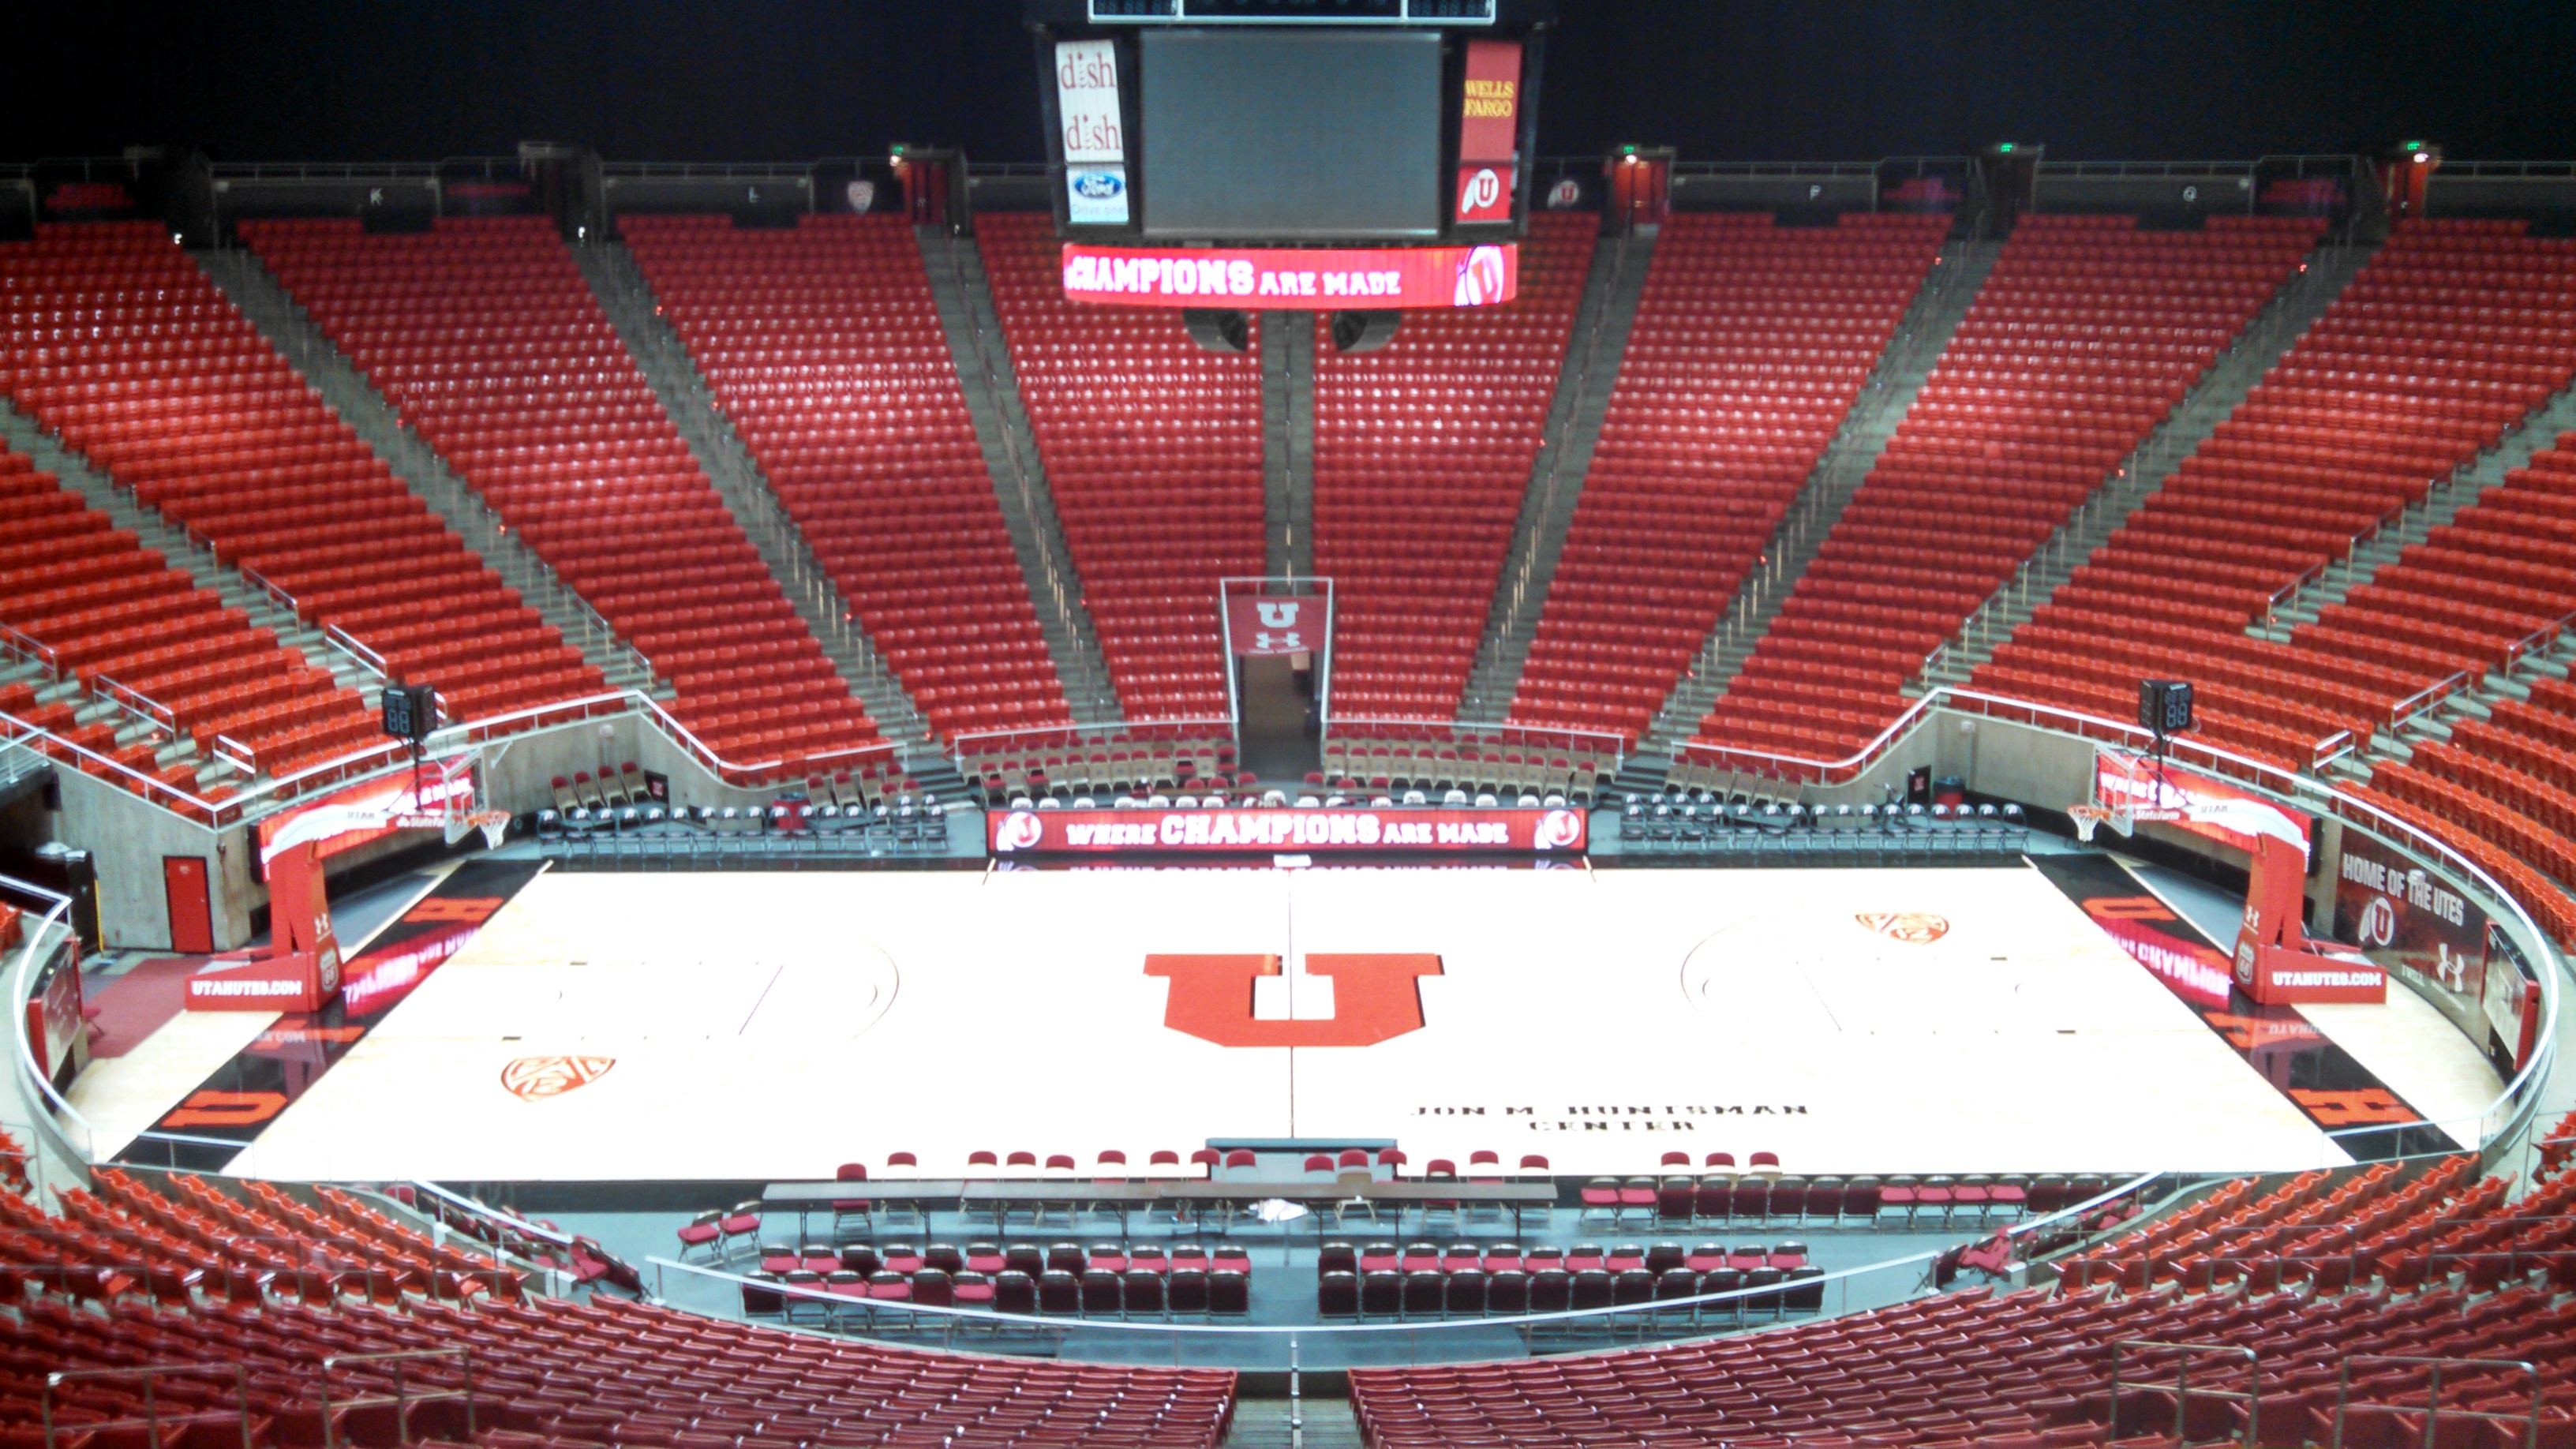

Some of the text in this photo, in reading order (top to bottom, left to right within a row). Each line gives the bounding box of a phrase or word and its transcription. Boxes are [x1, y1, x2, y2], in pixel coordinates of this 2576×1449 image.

[1465, 80, 1514, 99] WELLS
[1463, 99, 1513, 117] FARGO
[1081, 174, 1115, 196] Ford
[1259, 271, 1317, 295] ARE
[1322, 271, 1402, 295] MADE
[1256, 602, 1299, 628] U
[1066, 814, 1509, 845] WHERE CHAMPIONS ARE MADE
[2342, 852, 2464, 927] HOME OF THE UTES
[2374, 904, 2391, 942] U
[191, 980, 302, 996] UTAHUTES.COM
[2272, 972, 2382, 987] UTAHUTES.COM
[1143, 953, 1445, 1047] U
[1410, 1106, 1485, 1115] JON
[1568, 1106, 1808, 1115] HUNTSMAN
[1529, 1121, 1694, 1131] CENTER
